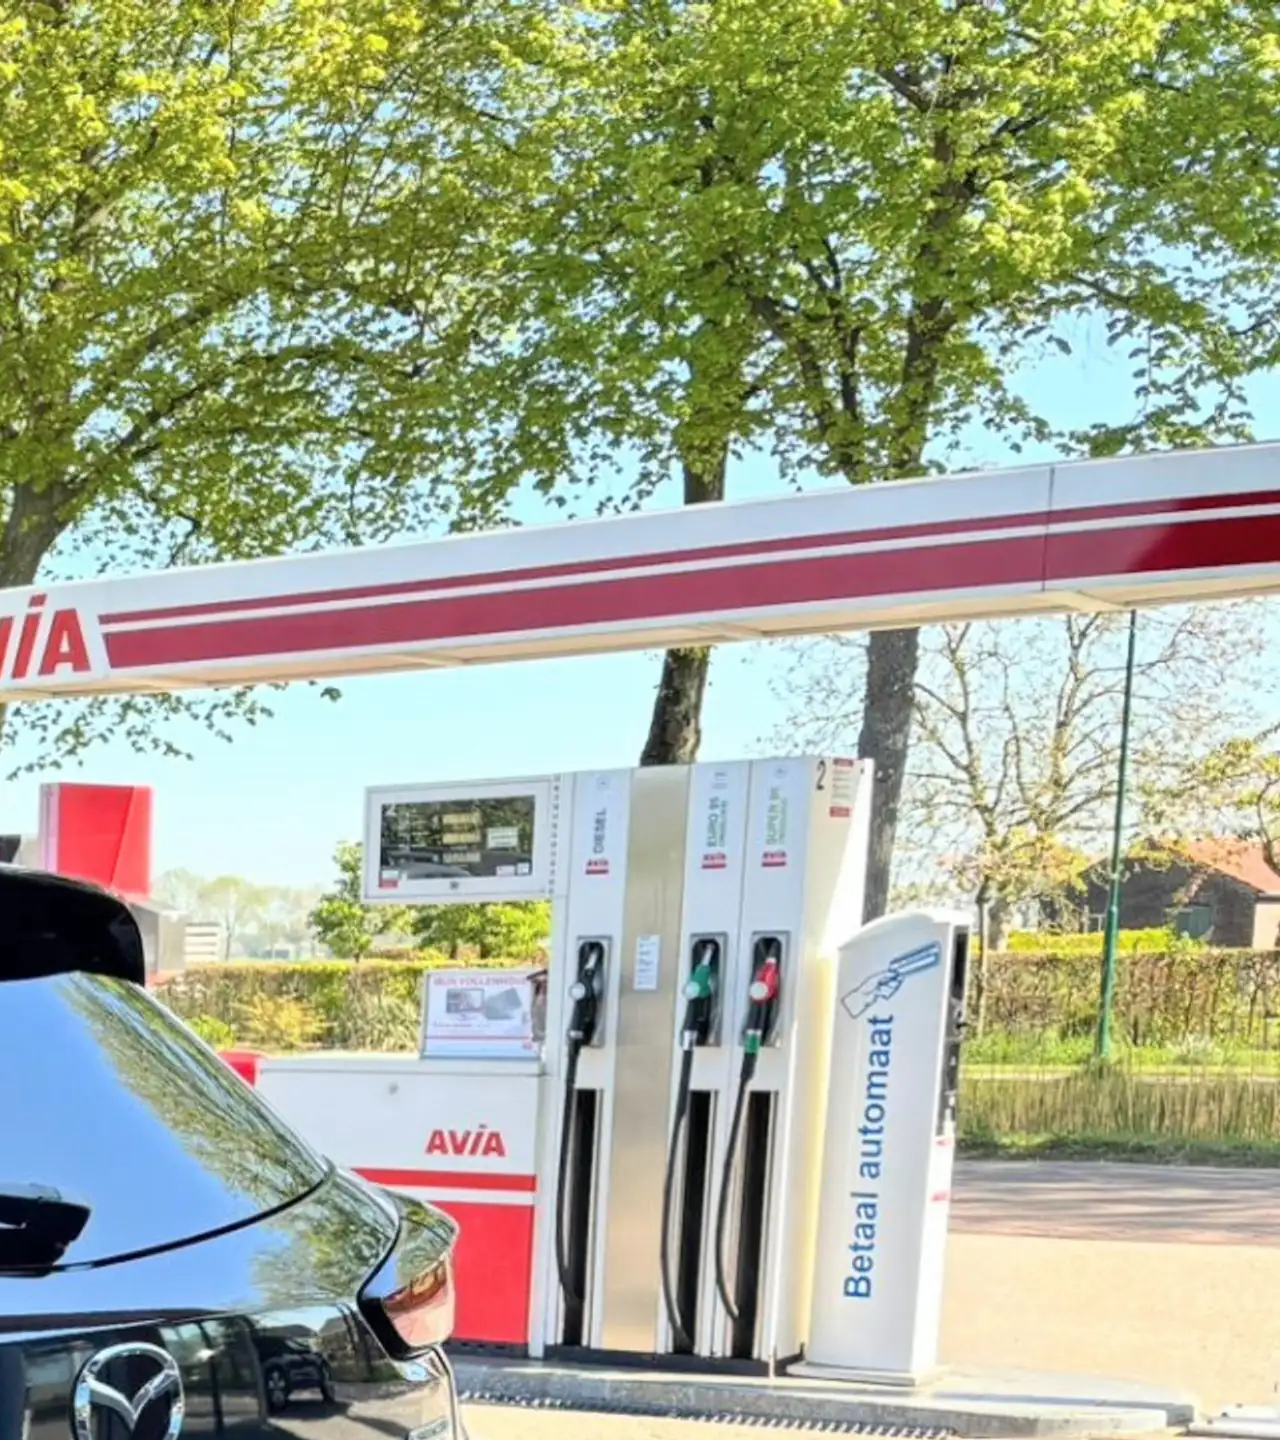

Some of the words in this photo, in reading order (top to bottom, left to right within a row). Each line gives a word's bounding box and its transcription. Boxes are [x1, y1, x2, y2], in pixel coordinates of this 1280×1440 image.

[592, 807, 607, 855] DIESEL
[856, 1014, 895, 1180] automaat
[844, 1191, 879, 1300] Betaal
